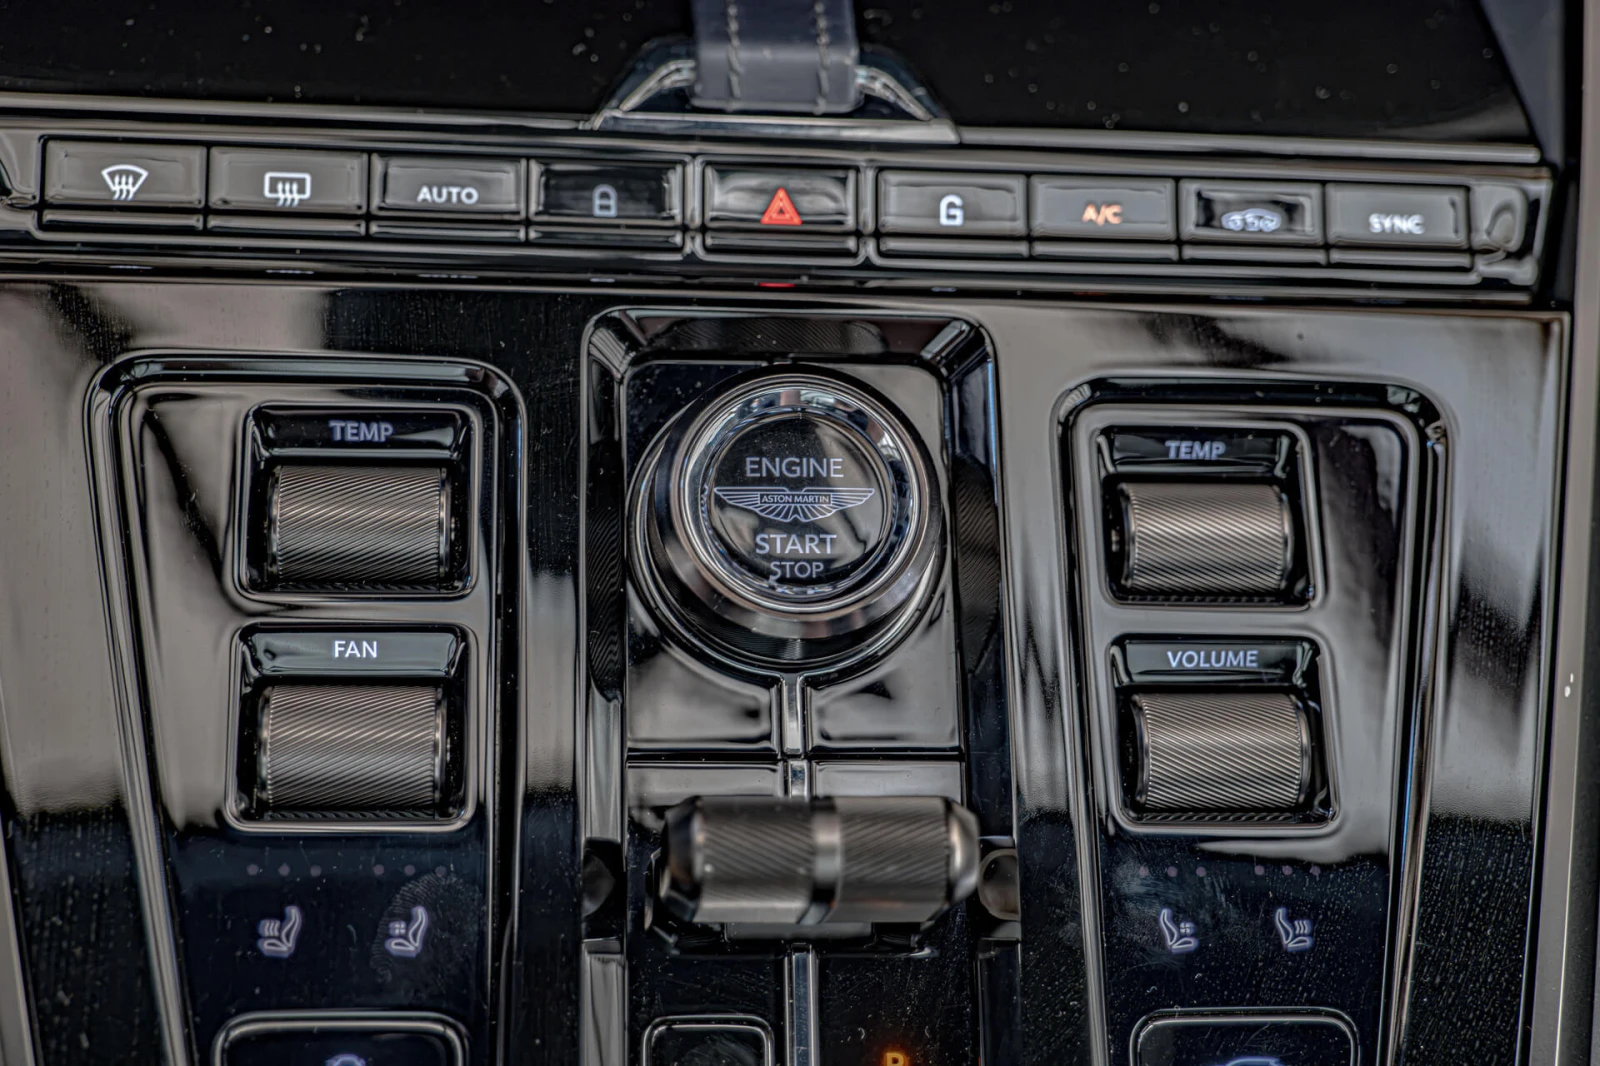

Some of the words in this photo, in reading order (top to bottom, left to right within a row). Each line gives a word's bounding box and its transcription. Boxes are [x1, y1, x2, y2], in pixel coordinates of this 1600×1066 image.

[417, 185, 479, 205] AUTO
[1082, 203, 1123, 226] A/C
[1369, 213, 1425, 235] SYNC
[328, 420, 394, 442] TEMP
[1164, 440, 1226, 460] TEMP
[745, 457, 844, 478] ENGINE
[761, 494, 793, 504] ASTON
[794, 494, 829, 504] MARTIN
[755, 533, 837, 555] START
[769, 561, 824, 579] STOP
[334, 640, 378, 658] FAN
[1166, 650, 1259, 668] VOLUME
